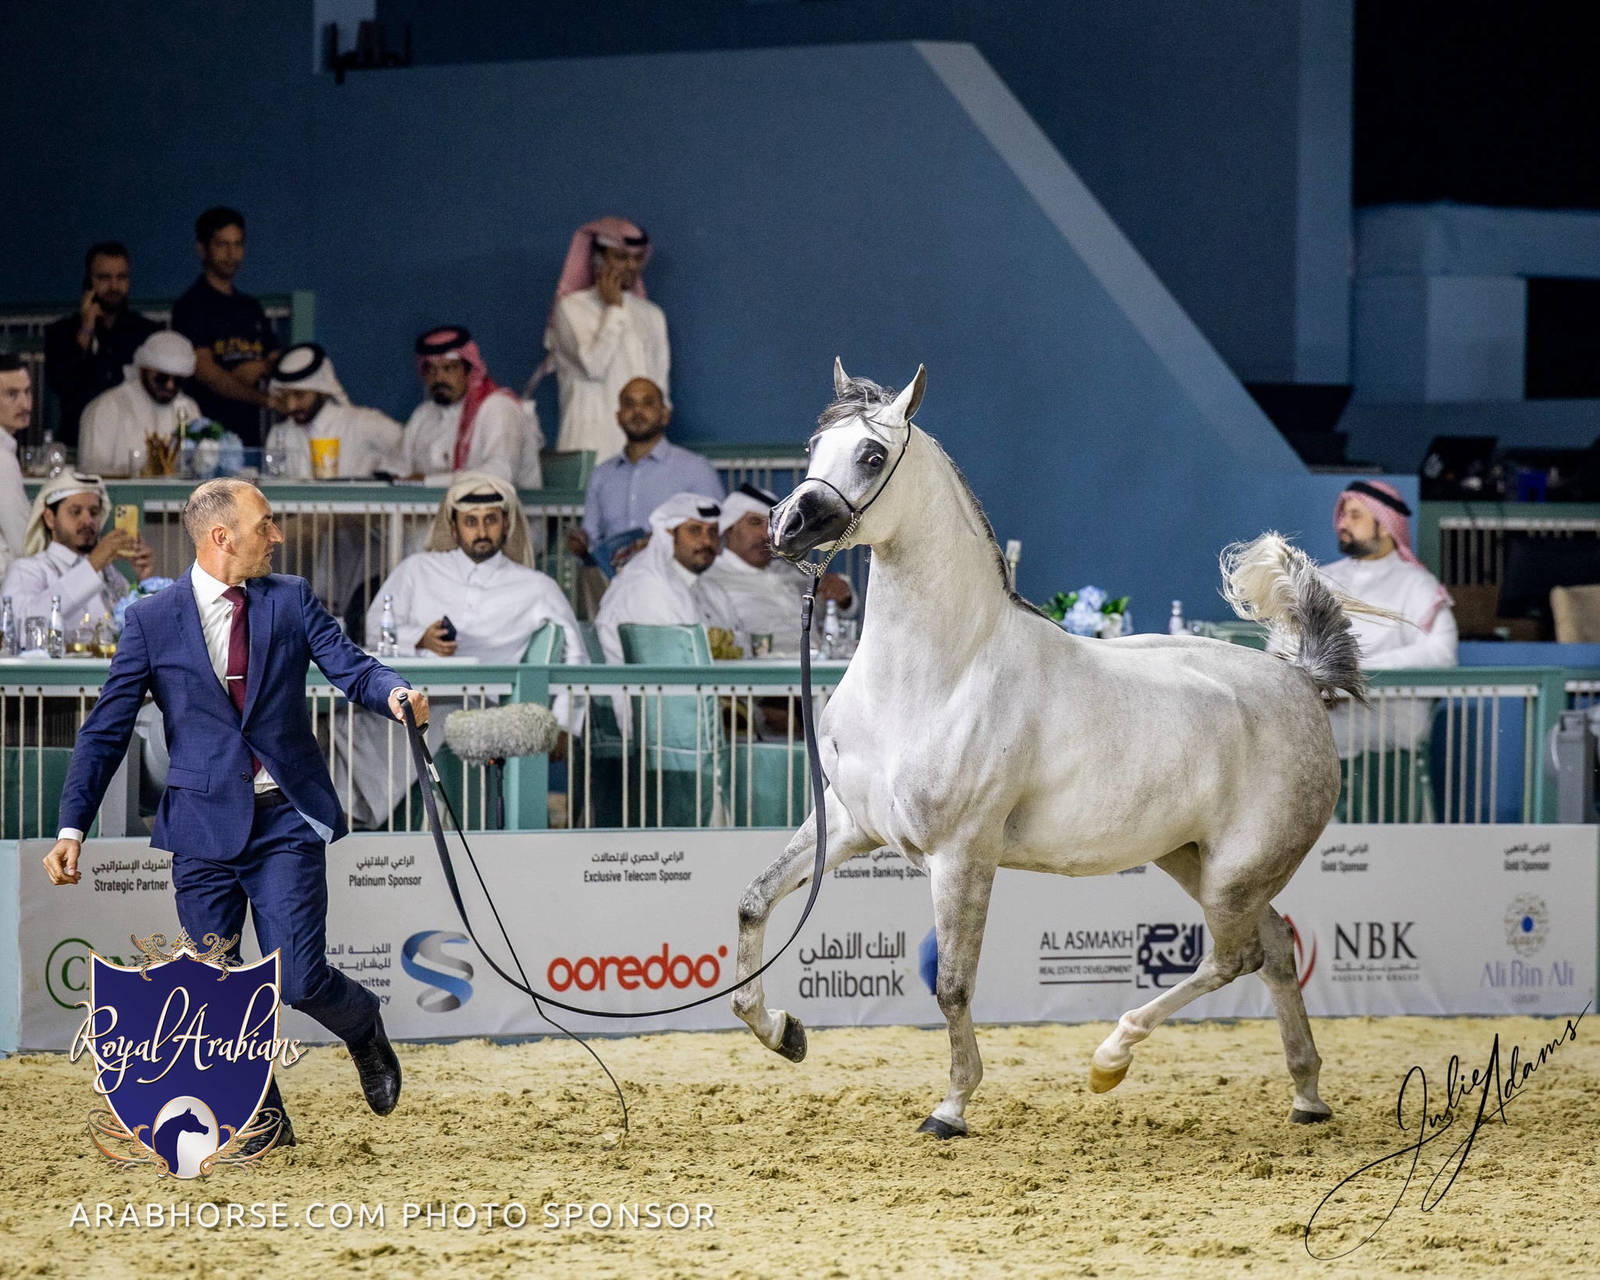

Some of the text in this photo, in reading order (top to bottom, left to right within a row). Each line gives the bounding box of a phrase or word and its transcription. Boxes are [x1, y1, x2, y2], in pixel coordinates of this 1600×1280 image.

[391, 855, 415, 870] الراعي
[661, 851, 684, 865] الراعي
[348, 873, 422, 888] Platinum Sponsor
[583, 868, 692, 883] Exclusive Telecom Sponsor
[833, 867, 870, 879] Exclusive
[872, 866, 904, 880] Banking
[94, 878, 169, 894] Strategic Partner
[865, 931, 905, 965] البنك
[1040, 930, 1134, 950] AL ASMAKH
[1333, 921, 1418, 960] NBK
[547, 943, 728, 993] ooredoo
[1039, 966, 1055, 975] REAL
[1057, 965, 1081, 975] ESTATE
[1480, 959, 1575, 988] Ali Bin Ali
[799, 969, 905, 999] ahlibank
